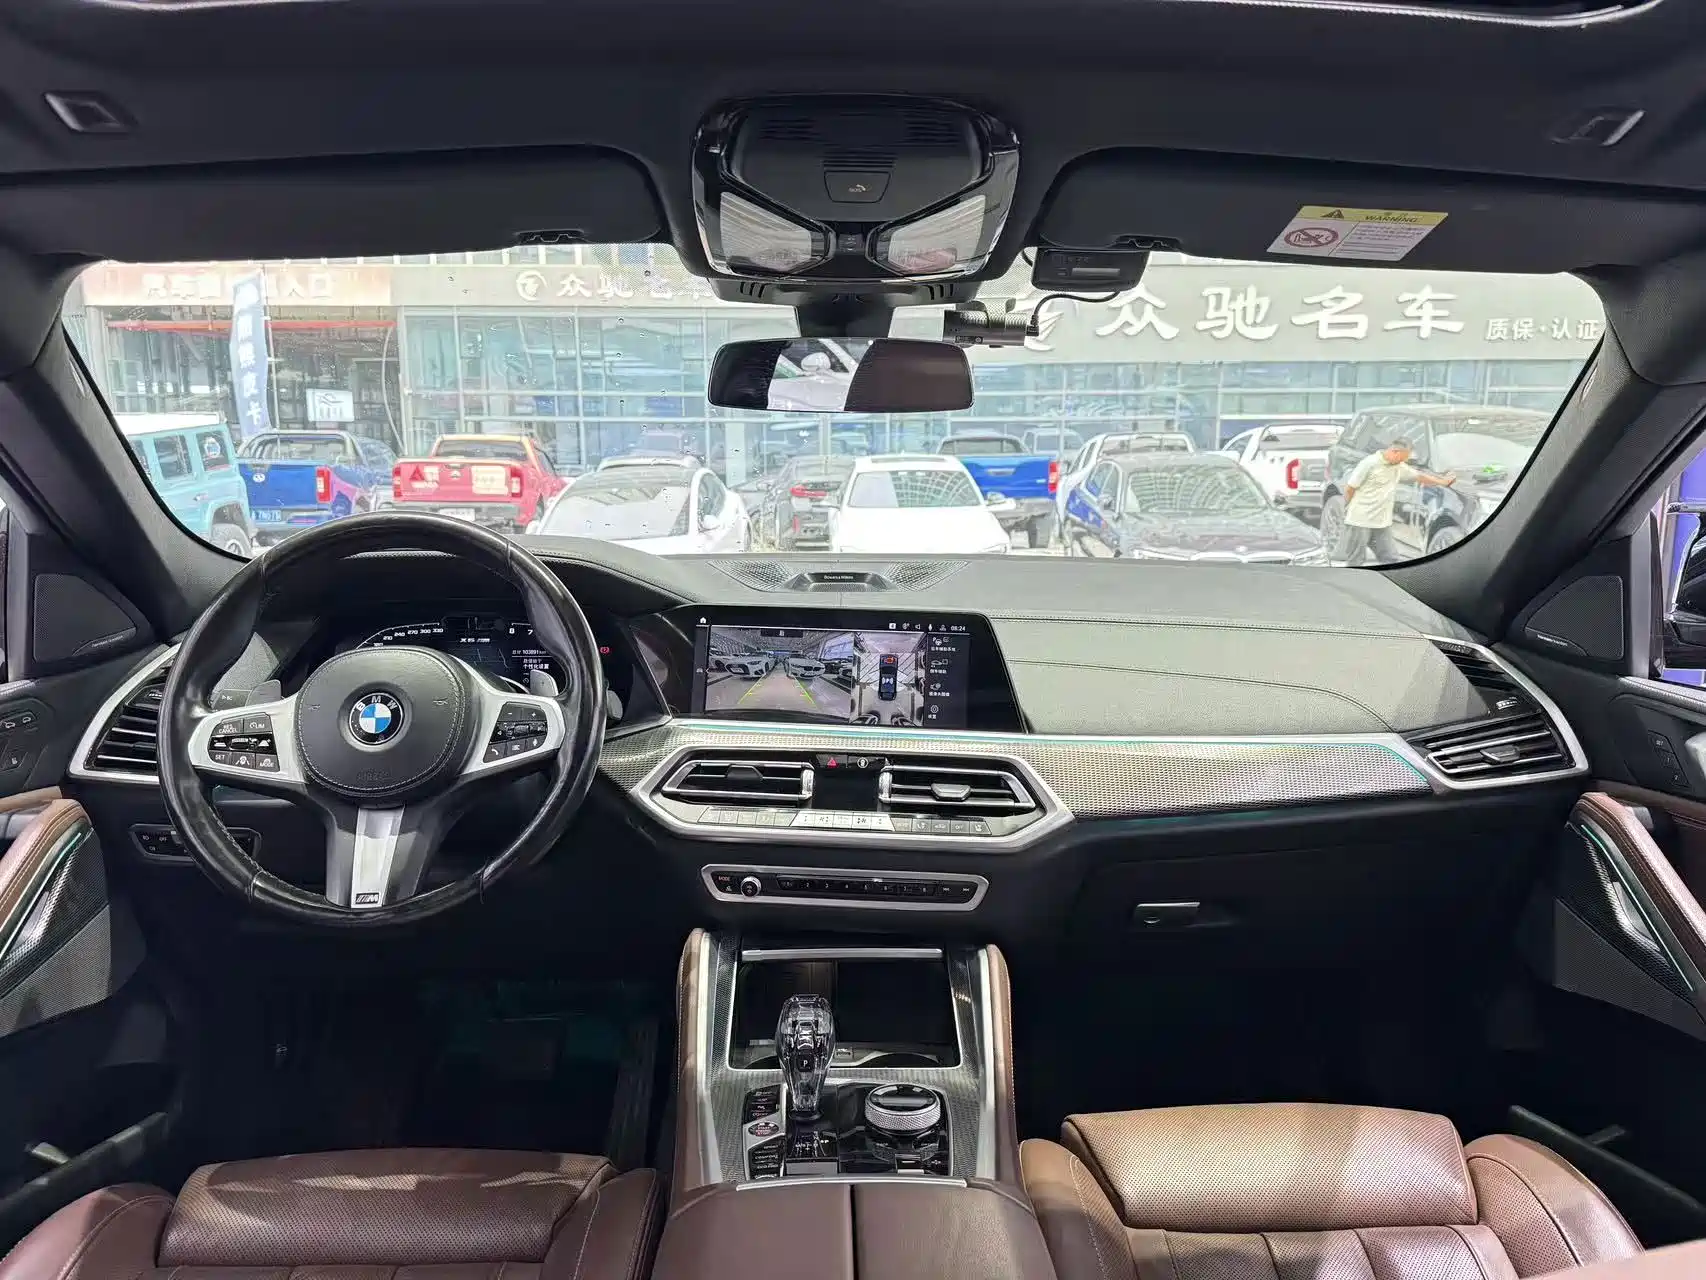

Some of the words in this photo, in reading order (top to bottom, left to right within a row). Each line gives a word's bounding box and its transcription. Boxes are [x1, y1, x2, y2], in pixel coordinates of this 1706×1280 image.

[1365, 215, 1418, 223] WARNING
[1095, 284, 1466, 340] 众驰名车
